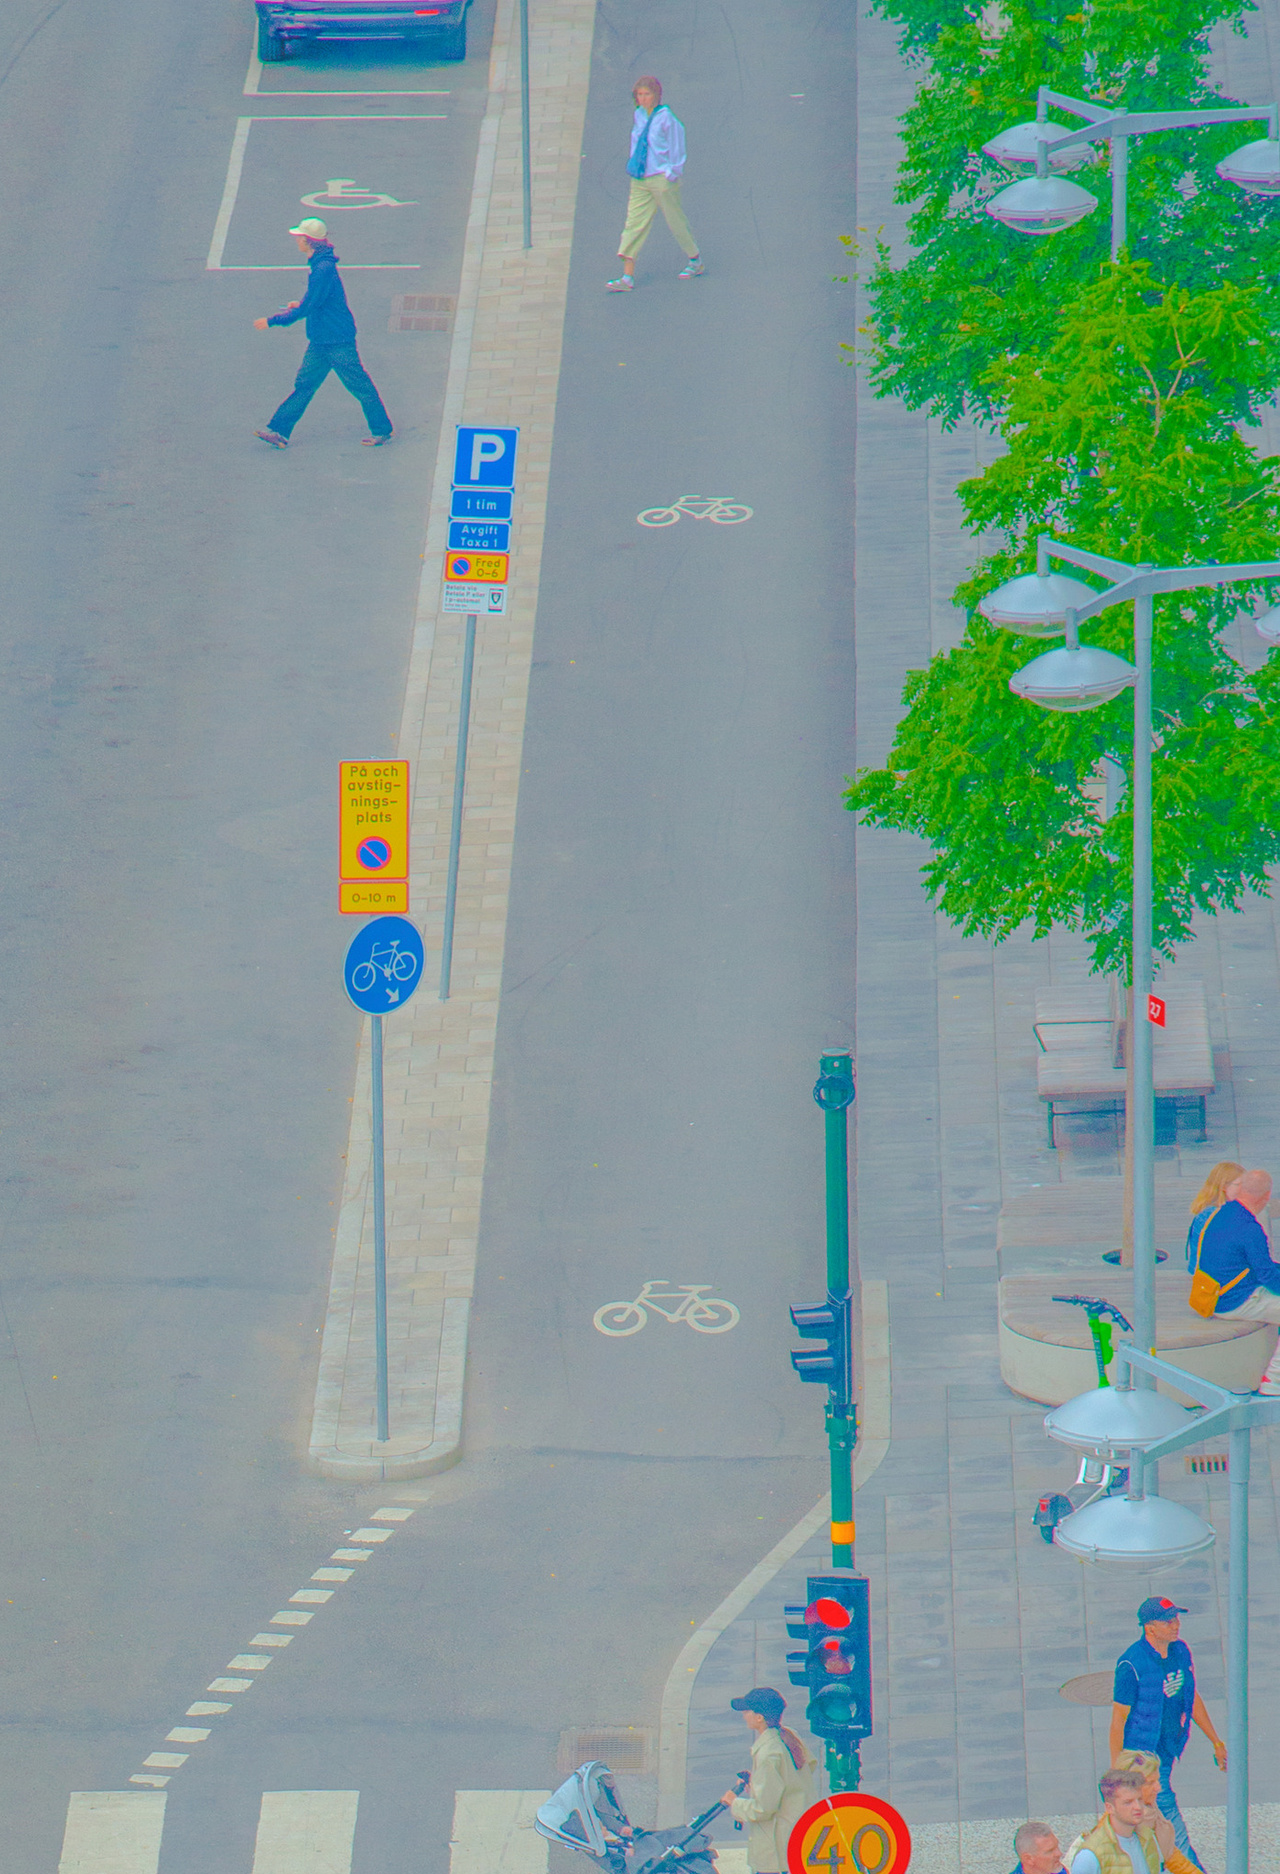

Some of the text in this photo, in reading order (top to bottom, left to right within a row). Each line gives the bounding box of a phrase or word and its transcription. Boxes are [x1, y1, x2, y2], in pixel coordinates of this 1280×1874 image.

[470, 433, 506, 480] P
[467, 498, 497, 511] 1 tim
[461, 524, 498, 536] Avgift
[460, 536, 498, 548] Taxa 1
[475, 557, 501, 568] Fred
[476, 568, 499, 578] 0-6
[350, 765, 398, 777] På och
[347, 778, 401, 793] avstig-
[351, 795, 398, 809] nings-
[356, 811, 392, 826] plats
[352, 893, 396, 903] 0-10 m
[1150, 1001, 1161, 1019] 27
